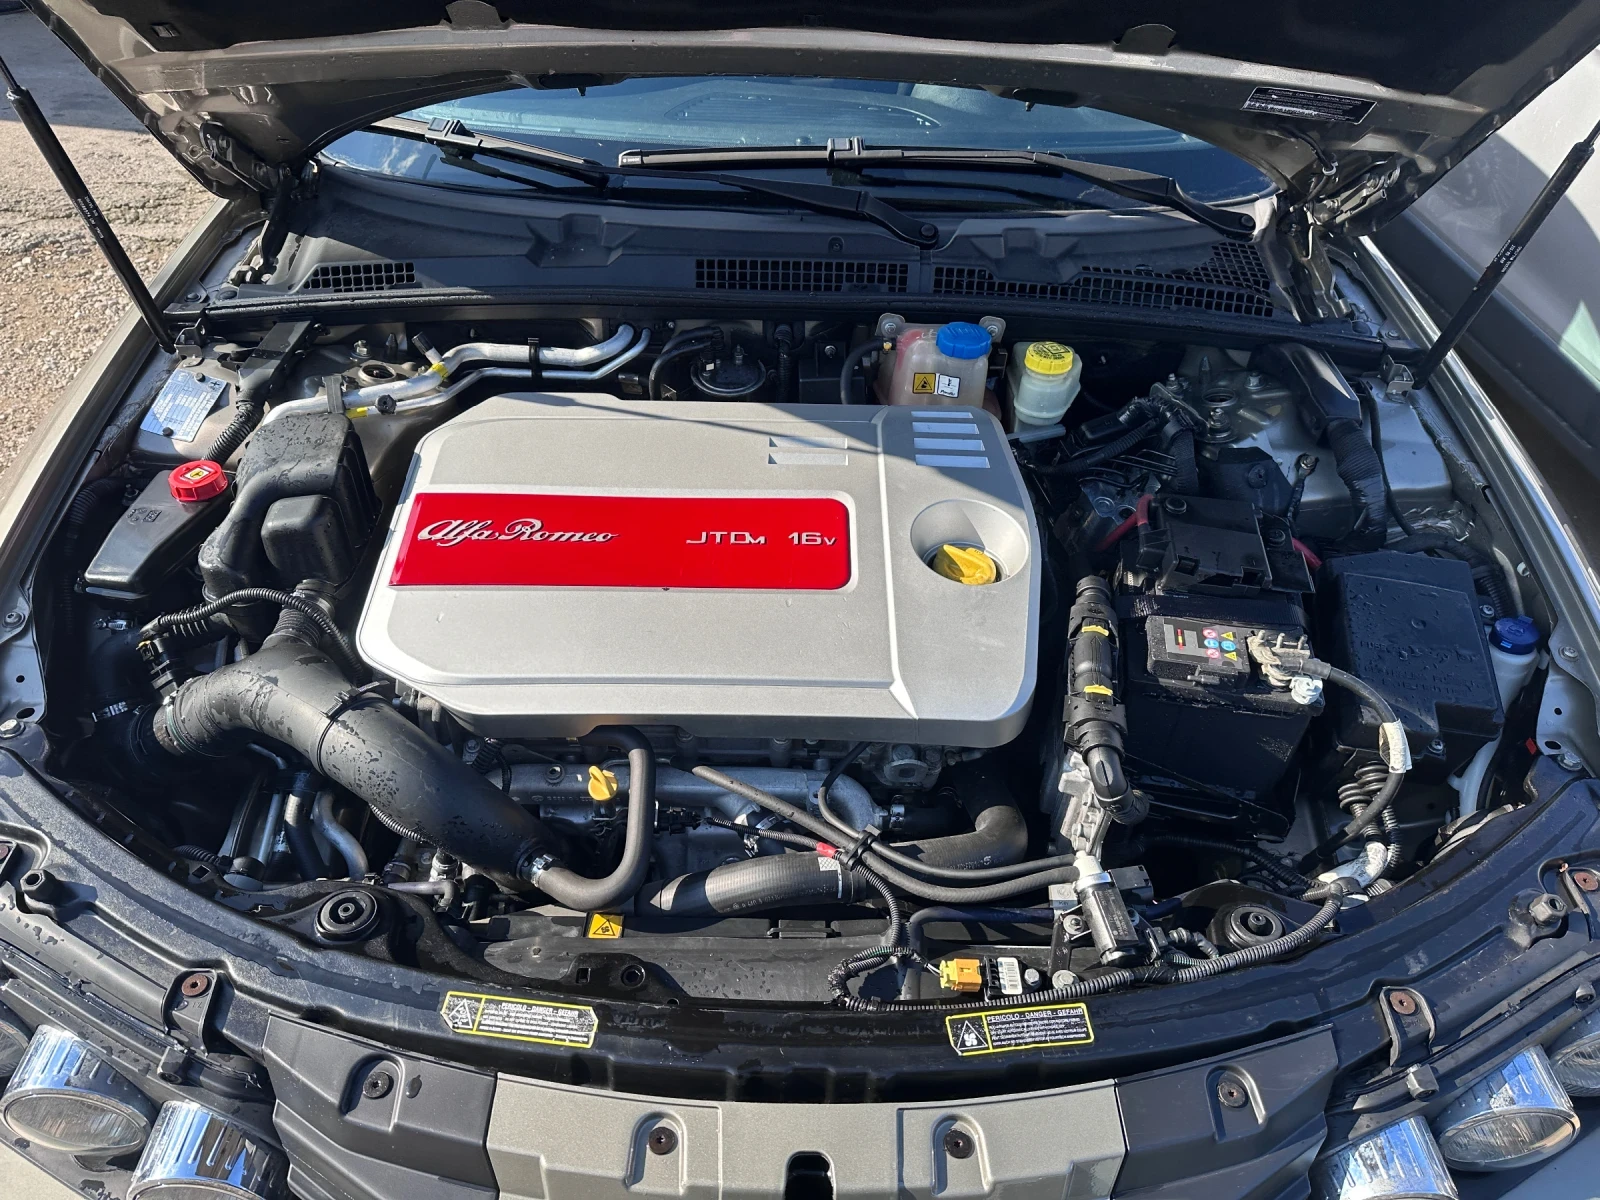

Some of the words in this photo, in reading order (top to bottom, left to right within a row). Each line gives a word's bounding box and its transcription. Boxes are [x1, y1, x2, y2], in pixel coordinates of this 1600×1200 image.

[417, 519, 499, 547] Alfa
[499, 518, 619, 542] Romeo
[501, 1002, 527, 1011] PERICOLO
[532, 1005, 554, 1014] DANGER
[987, 1013, 1020, 1023] PERICOLO
[1025, 1010, 1052, 1019] DANGER
[1057, 1008, 1084, 1016] GEFAHR
